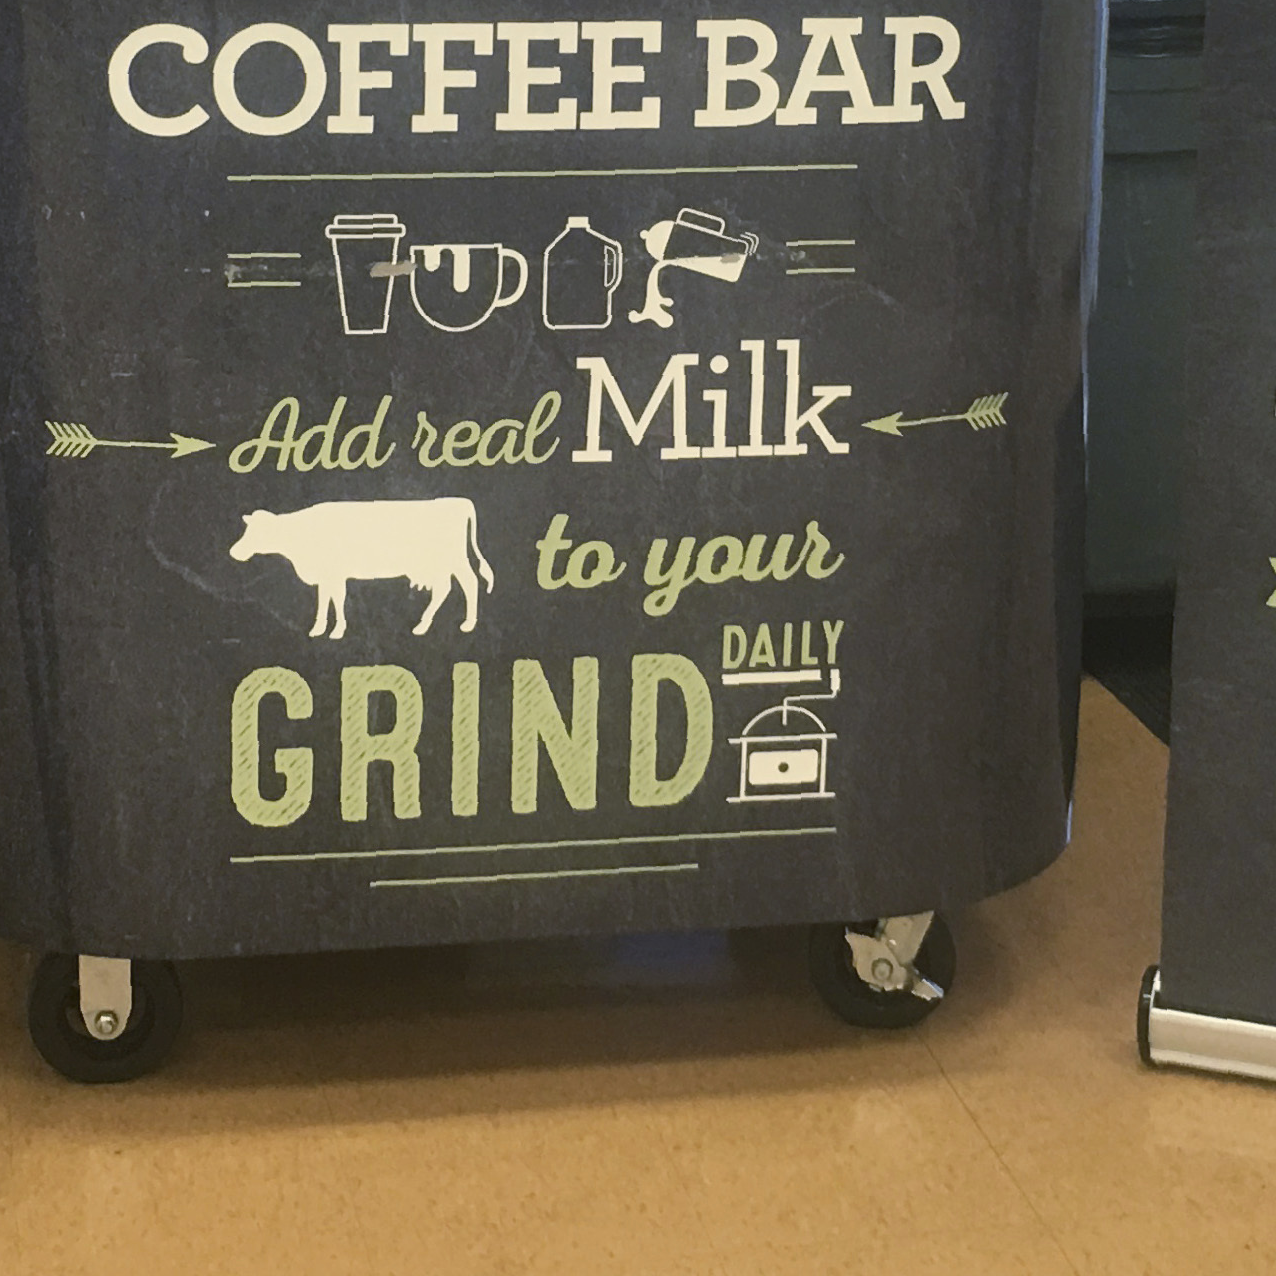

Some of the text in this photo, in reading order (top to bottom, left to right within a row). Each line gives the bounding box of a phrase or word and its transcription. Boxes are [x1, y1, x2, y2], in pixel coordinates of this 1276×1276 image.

[109, 15, 966, 137] COFFEE BAR
[227, 339, 853, 473] Add real Milk
[534, 514, 845, 617] to your
[721, 619, 846, 671] DAILY
[229, 652, 715, 829] GRIND
